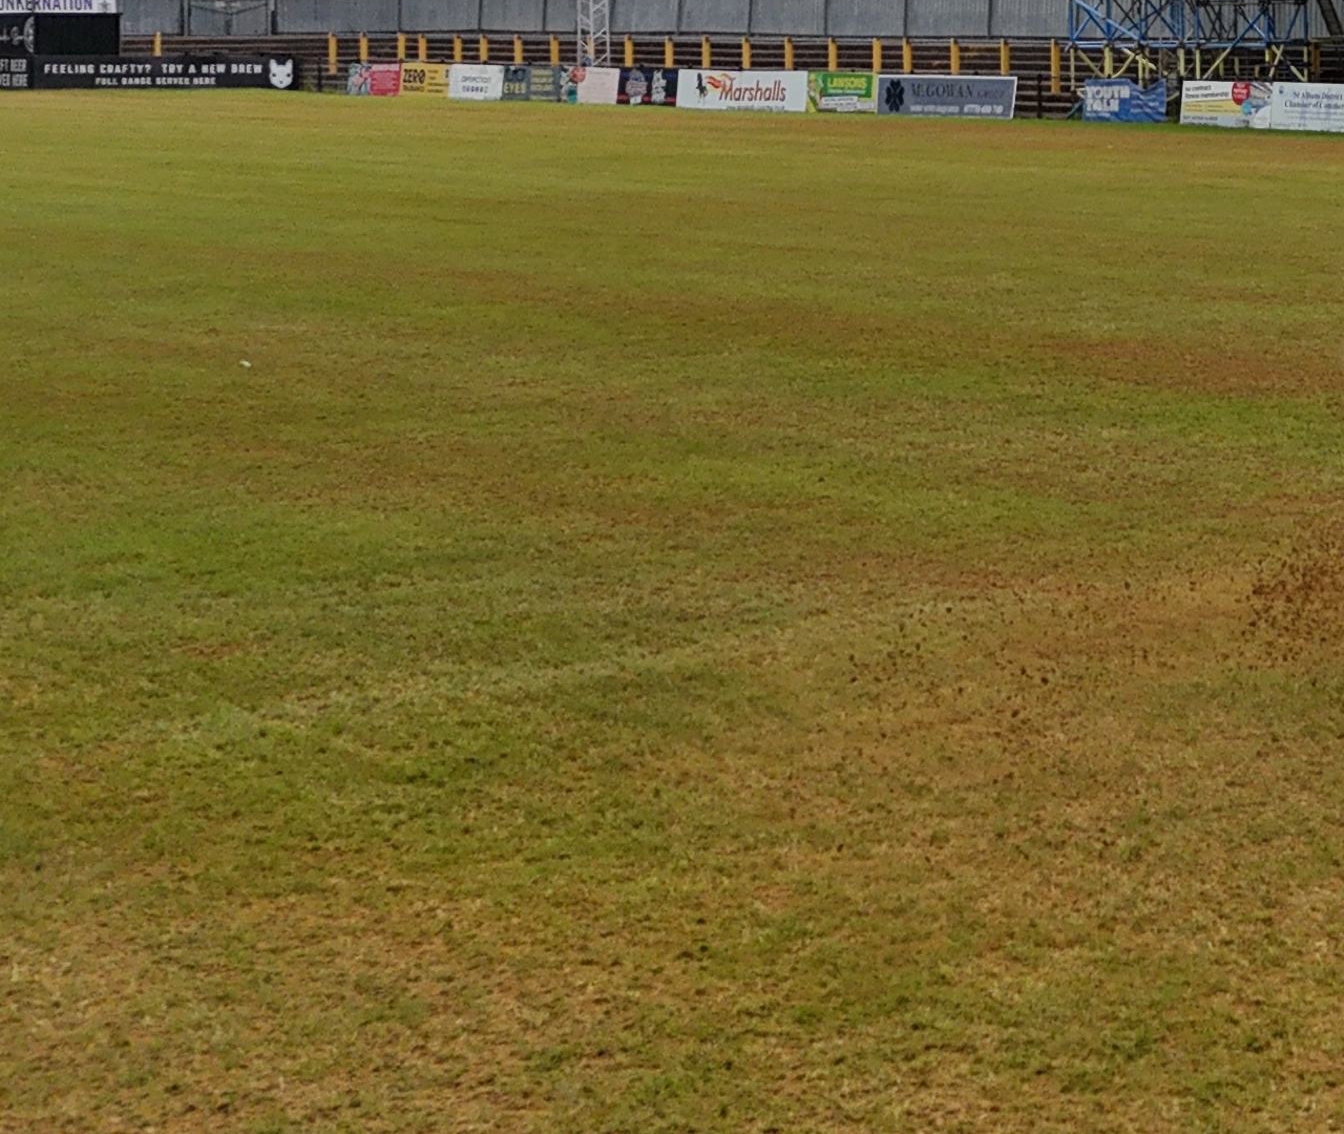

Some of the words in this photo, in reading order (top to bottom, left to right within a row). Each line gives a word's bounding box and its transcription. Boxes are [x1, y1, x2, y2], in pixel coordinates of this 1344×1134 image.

[44, 64, 95, 74] FEELING
[100, 64, 152, 74] CRAFTY?
[161, 64, 184, 74] TRY
[188, 64, 197, 74] A
[201, 64, 226, 74] NEW
[231, 64, 262, 74] BREW
[403, 69, 426, 85] ZERO
[719, 76, 786, 102] Marshalls
[1085, 85, 1131, 99] YOUTH
